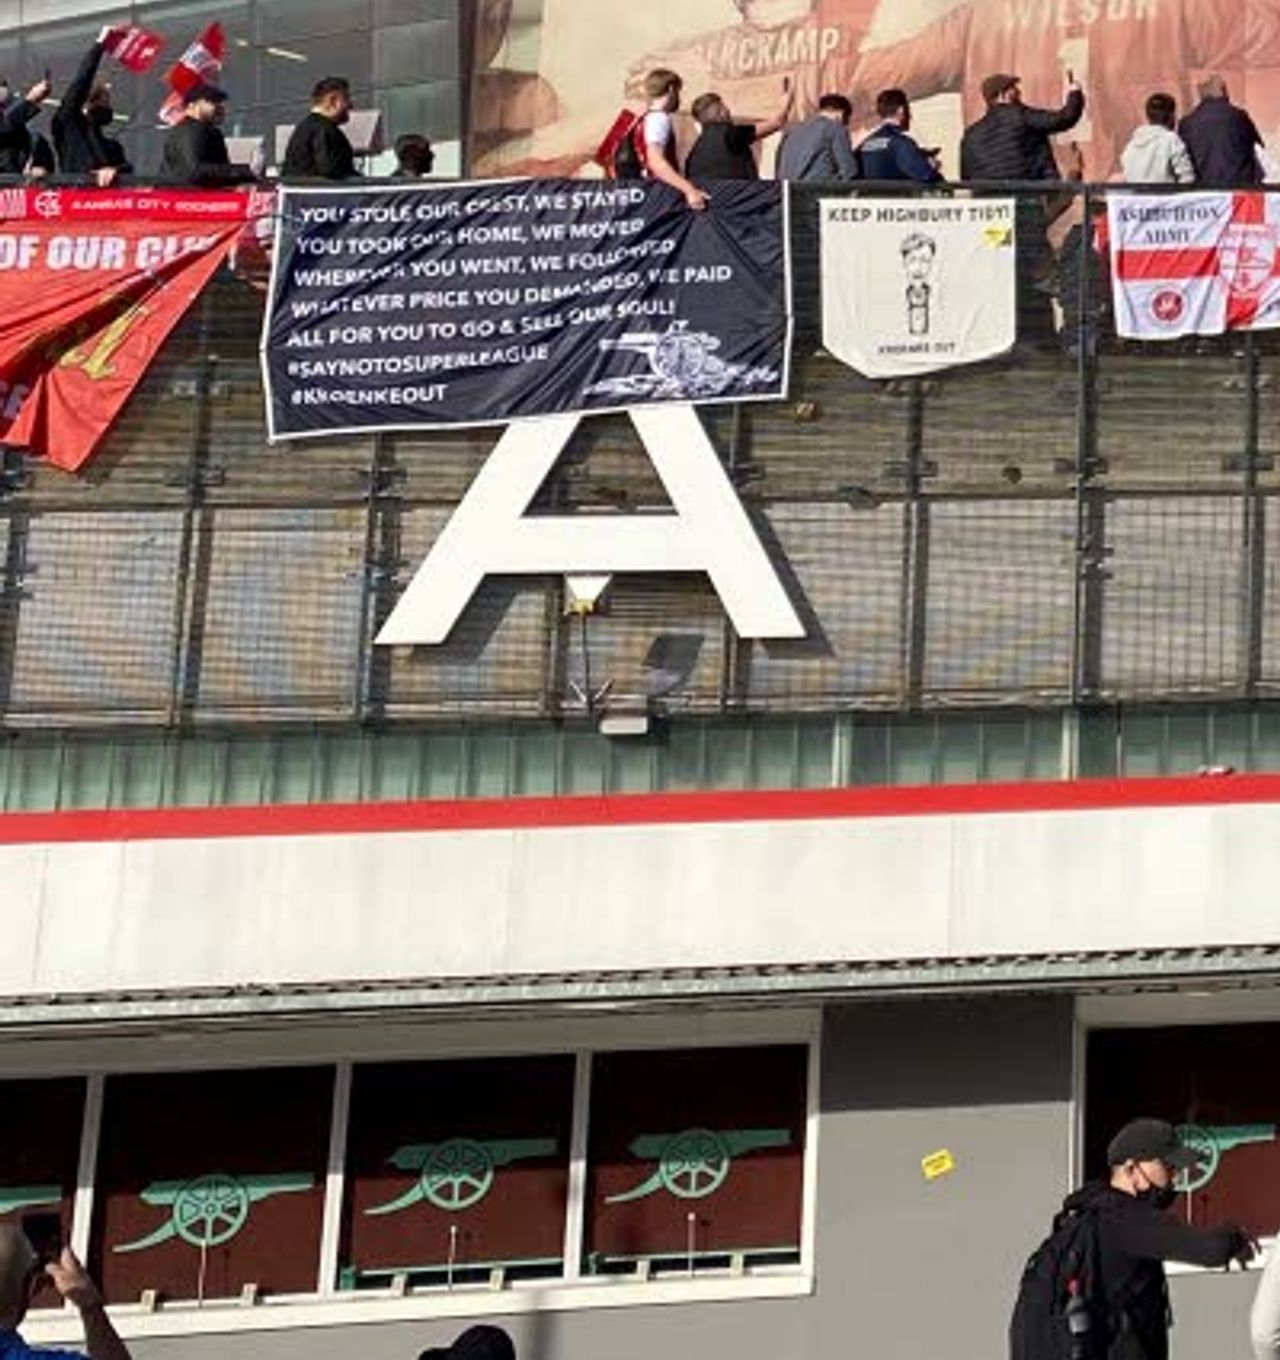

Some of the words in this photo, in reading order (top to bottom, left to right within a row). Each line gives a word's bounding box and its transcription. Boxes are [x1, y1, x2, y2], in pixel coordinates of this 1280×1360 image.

[299, 206, 345, 223] YOU
[349, 204, 411, 223] STOLE
[534, 192, 568, 210] WE
[572, 187, 646, 210] STAYED
[828, 207, 873, 223] KEEP
[877, 206, 963, 223] HIGHBURY
[46, 234, 128, 271] OUR
[297, 237, 342, 255] YOU
[347, 236, 408, 255] TOOK
[531, 222, 565, 241] WE
[569, 217, 645, 239] MOVED
[409, 257, 457, 278] YOU
[530, 253, 563, 272] WE
[409, 290, 470, 309] PRICE
[473, 286, 521, 307] YOU
[684, 264, 733, 283] PAID
[285, 330, 325, 348] ALL
[328, 326, 374, 345] FOR
[376, 322, 425, 343] YOU
[429, 321, 457, 339] TO
[460, 319, 496, 338] GO
[499, 317, 516, 335] &
[568, 306, 614, 325] OUR
[287, 343, 550, 379] #SAYNOTOSUPERLEAGUE
